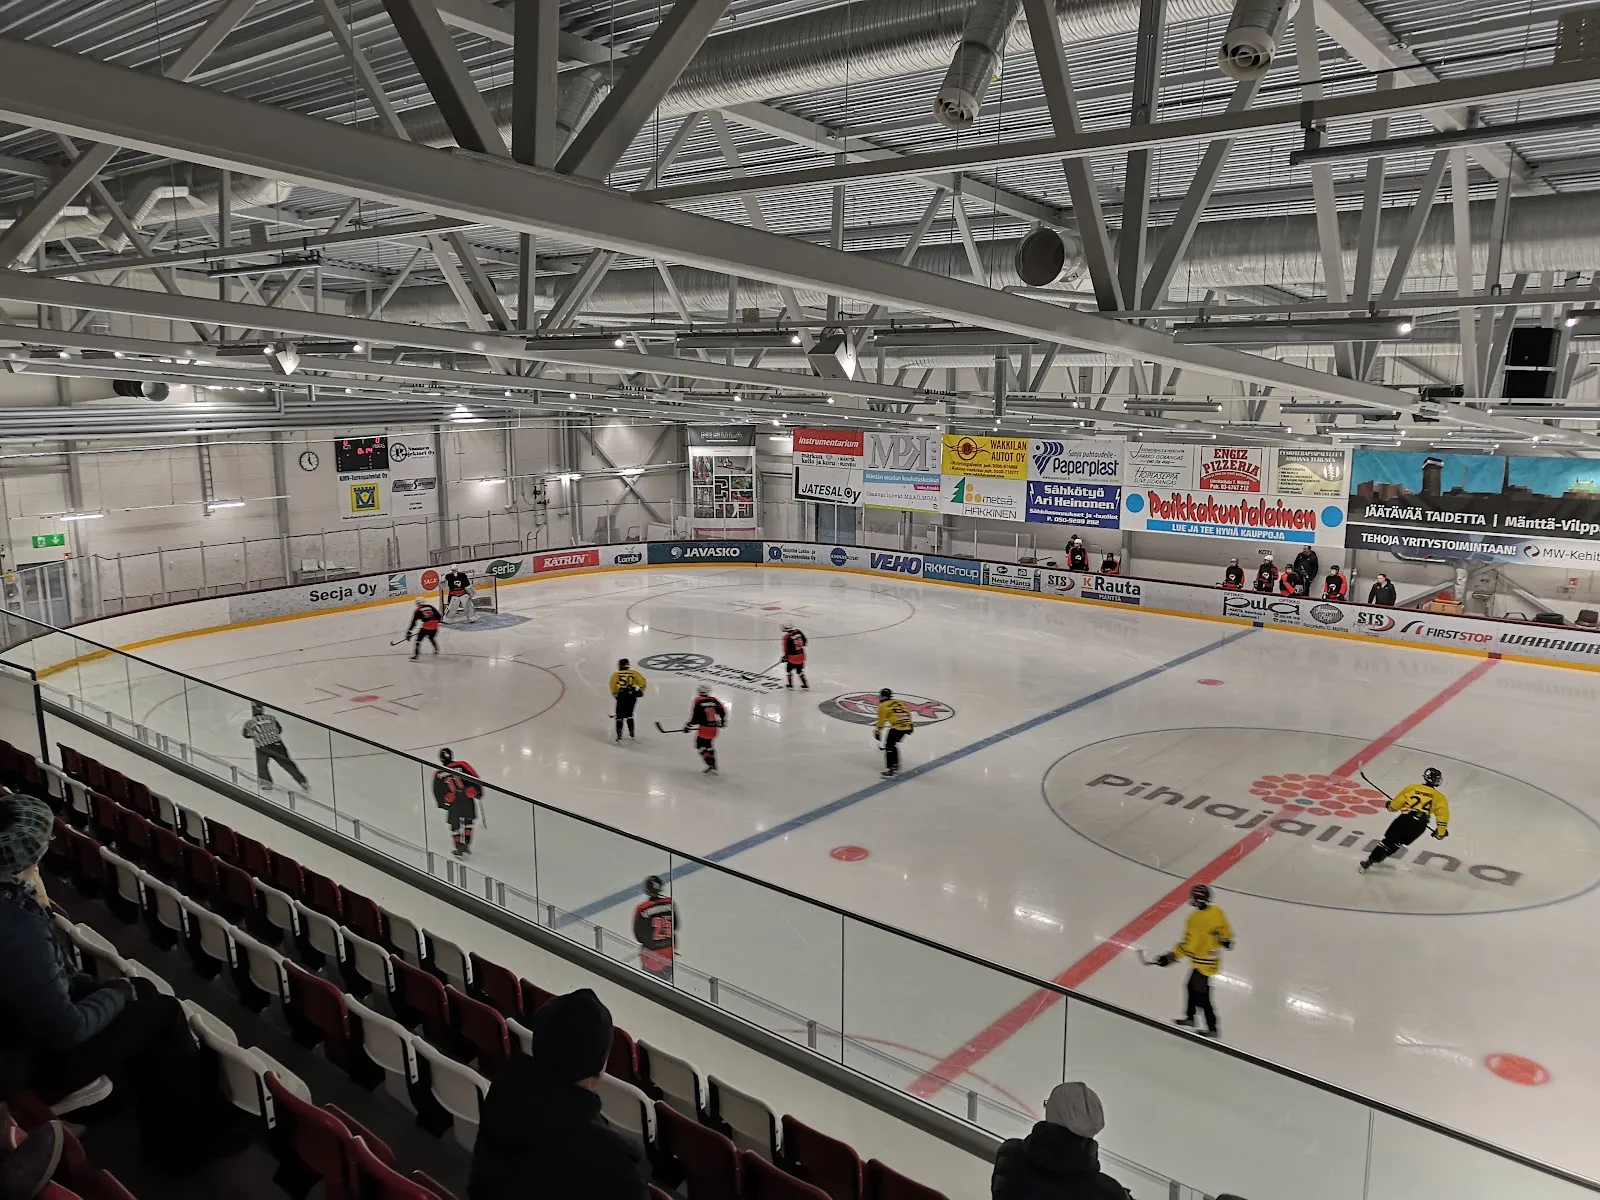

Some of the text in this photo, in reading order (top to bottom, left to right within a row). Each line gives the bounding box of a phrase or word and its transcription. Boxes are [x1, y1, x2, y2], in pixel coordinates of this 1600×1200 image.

[798, 436, 859, 448] instrumentarium
[990, 440, 1026, 450] WAKKILAN
[992, 452, 1026, 462] AUTOT OY
[1214, 448, 1248, 460] ENGIZ
[1202, 460, 1260, 476] PIZZERIA
[1044, 484, 1104, 499] Sähkötyö
[1034, 496, 1114, 510] Ari Heinonen
[1148, 490, 1317, 531] Paikkakuntalainen
[1364, 504, 1423, 520] JÄÄTÄVÄÄ
[1425, 510, 1486, 526] TAIDETTA
[1172, 523, 1285, 540] LUE JA TEE HYVIÄ KAUPPOJA
[1360, 532, 1400, 546] TEHOJA
[1401, 537, 1516, 556] YRITYSTOIMINTAAN!
[684, 548, 740, 558] JAVASKO
[542, 554, 588, 568] KATRIN
[870, 552, 922, 574] VEHO
[492, 564, 516, 574] serla
[924, 562, 979, 580] RKMGroup
[992, 576, 1008, 584] Neste
[1048, 574, 1066, 586] STS
[1094, 576, 1140, 596] Rauta
[310, 586, 352, 602] Secja
[358, 583, 376, 596] Oy
[1358, 612, 1384, 626] STS
[1426, 628, 1493, 643] FIRSTSTOP
[1500, 634, 1600, 654] WARRIOR
[1410, 796, 1432, 814] 24
